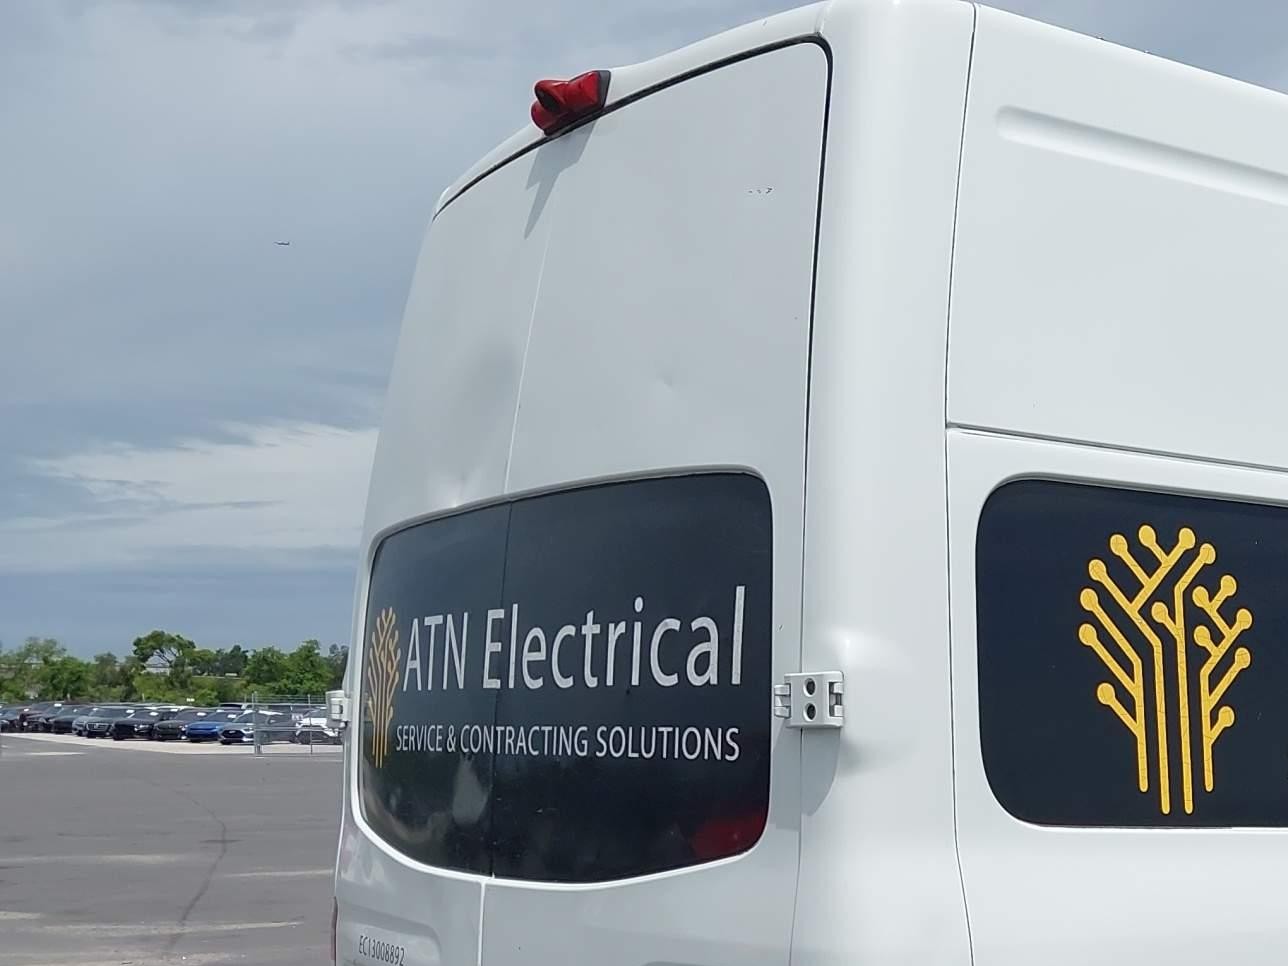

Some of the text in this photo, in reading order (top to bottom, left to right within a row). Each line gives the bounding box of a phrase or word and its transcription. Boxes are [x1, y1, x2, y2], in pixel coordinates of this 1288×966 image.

[402, 585, 746, 691] ATN Electrical
[396, 724, 741, 762] SERVICE & CONTRACTING SOLUTIONS
[358, 935, 405, 966] EC13008892
